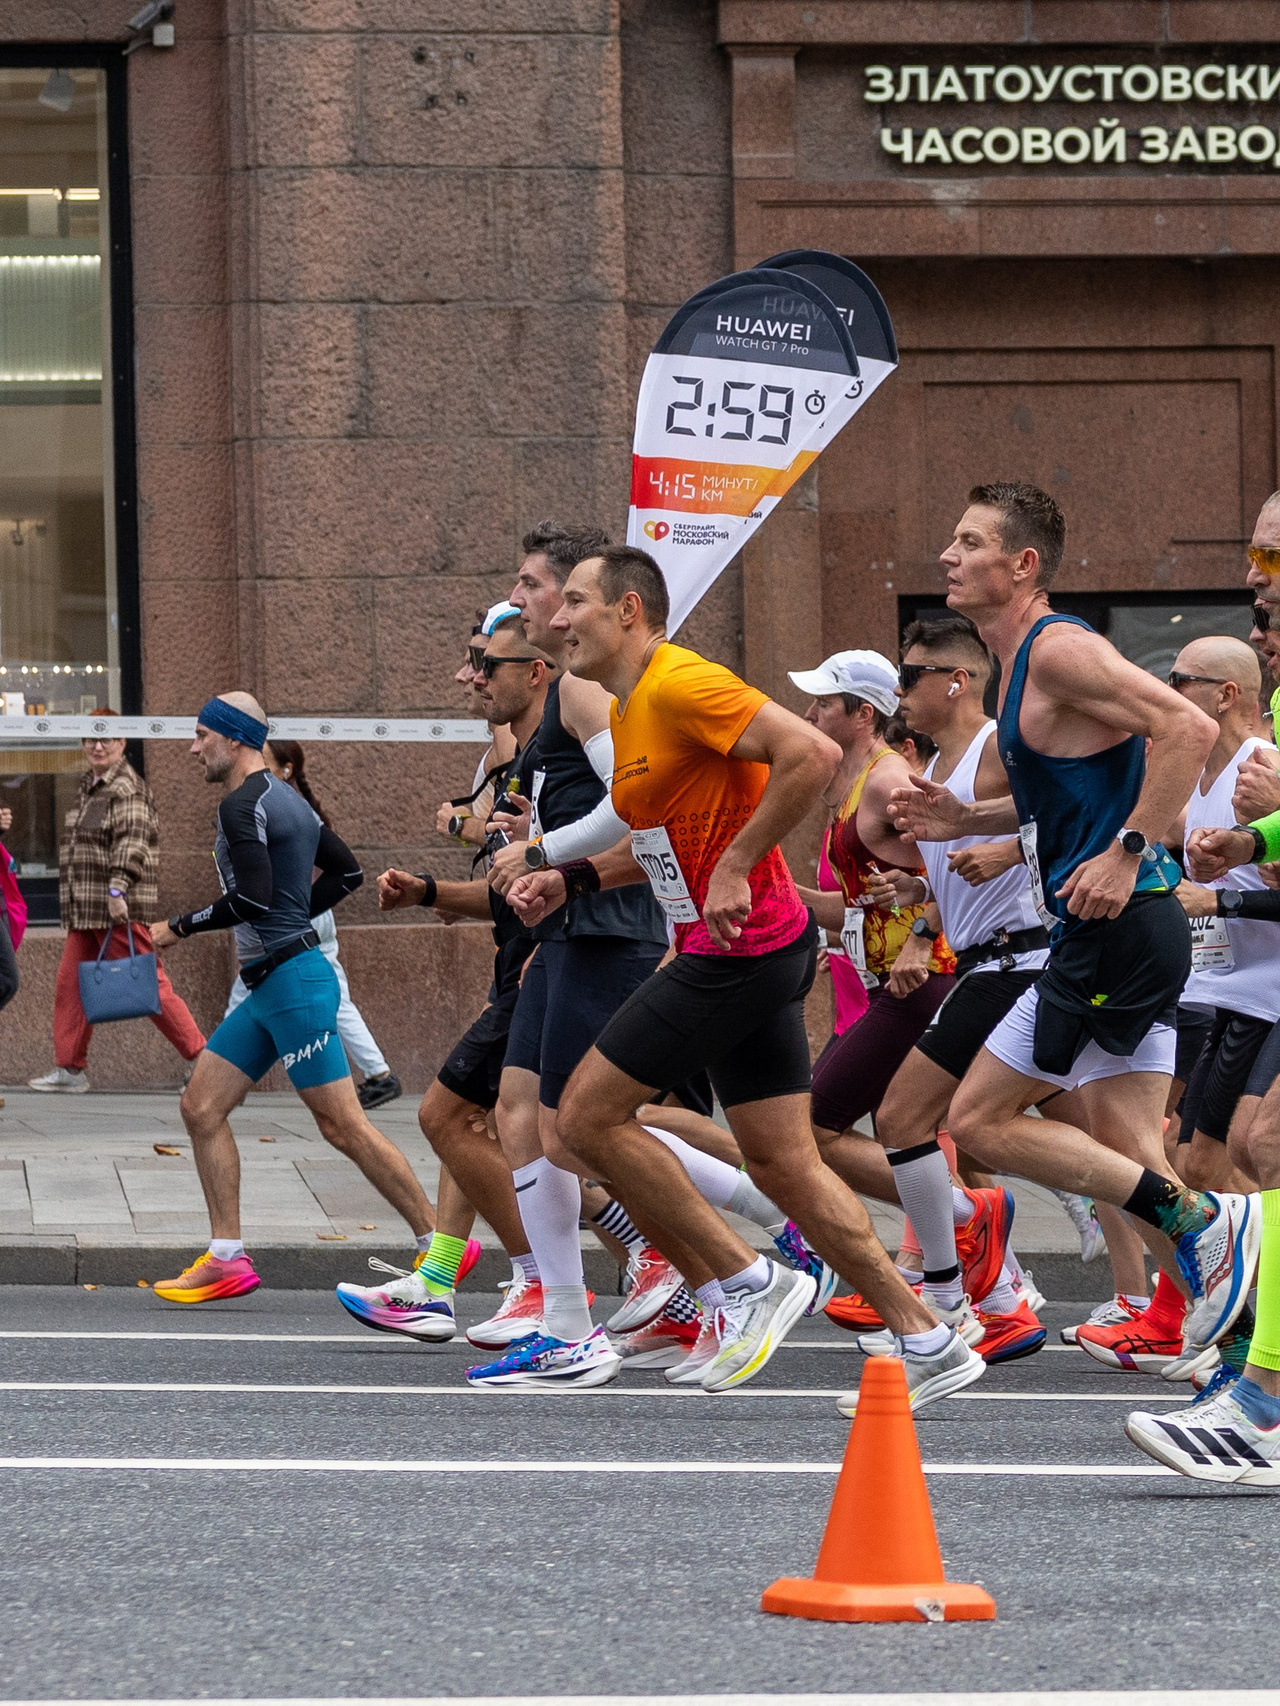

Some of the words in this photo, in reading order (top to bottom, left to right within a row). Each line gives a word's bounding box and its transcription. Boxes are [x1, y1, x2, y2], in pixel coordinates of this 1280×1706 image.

[880, 118, 1127, 163] ЧАСОВОЙ
[716, 315, 812, 341] HUAWEI
[716, 335, 759, 350] WATCH
[762, 339, 776, 352] GT
[790, 343, 809, 355] Pro
[666, 375, 794, 445] 2:59
[650, 471, 696, 499] 4:15
[703, 475, 758, 491] МИНУТ/
[701, 489, 723, 502] КМ
[673, 530, 729, 540] МОСКОВСКИЙ
[674, 523, 715, 531] СБЕРПРАЙМ
